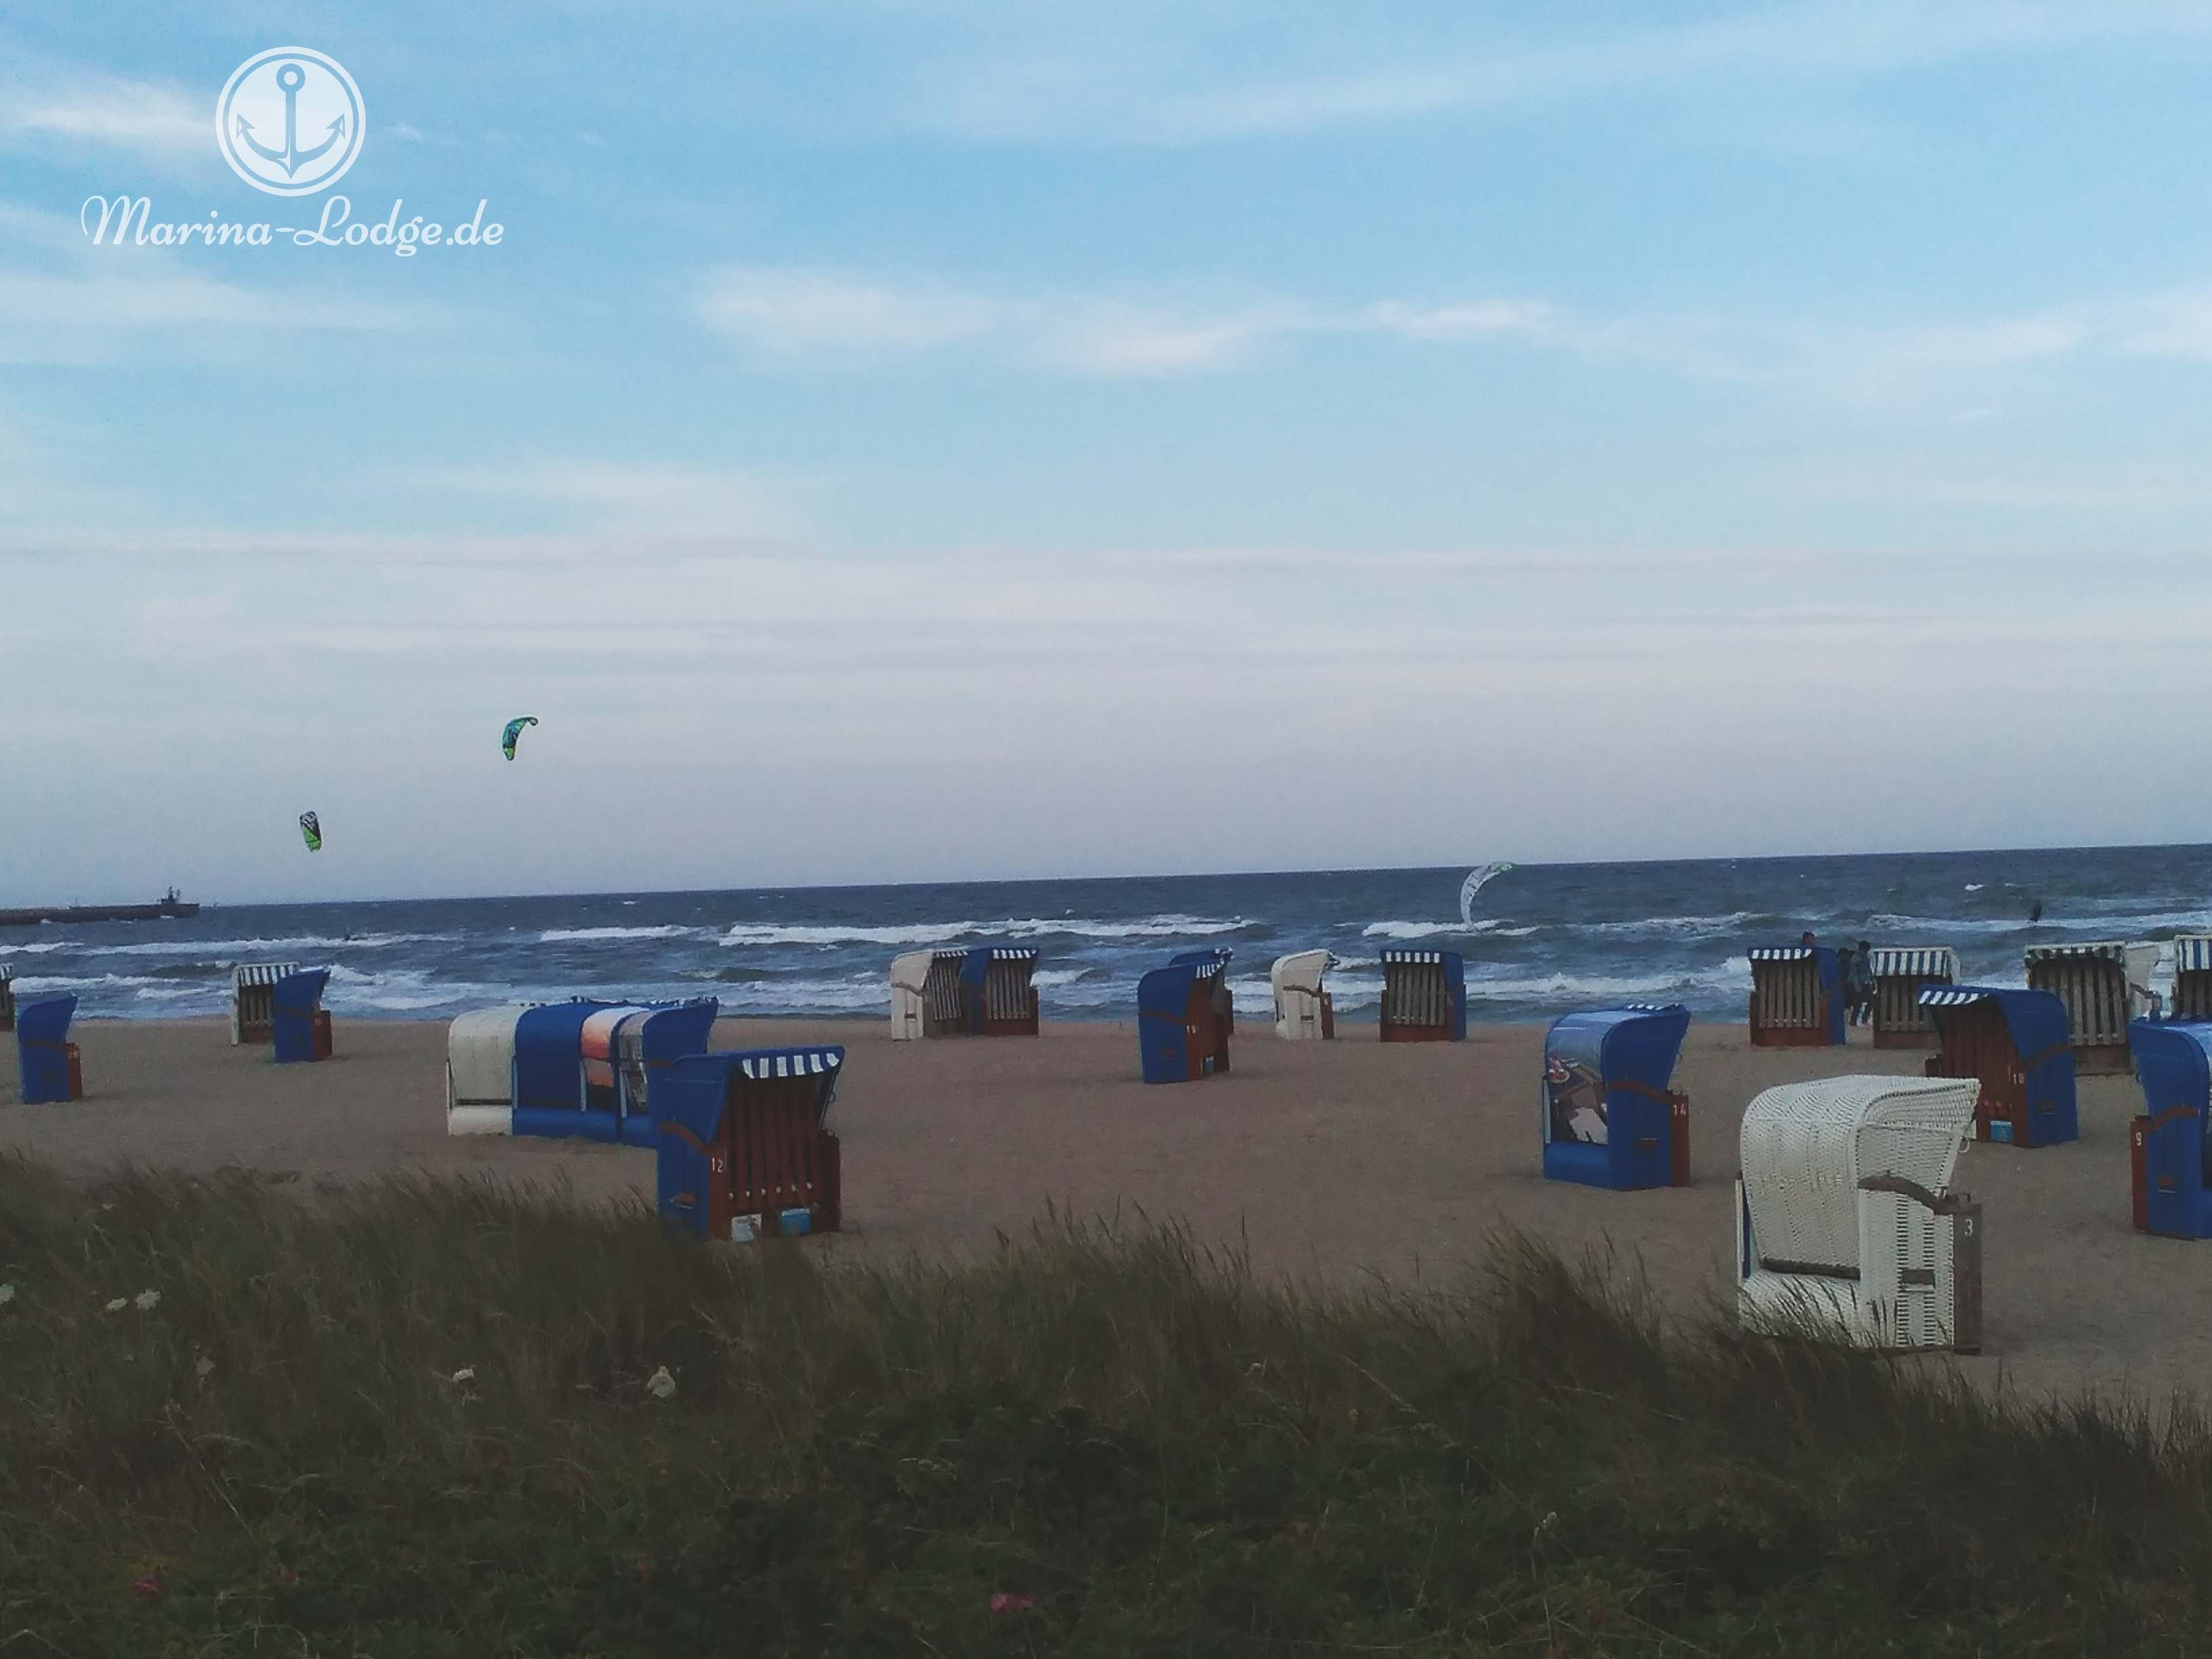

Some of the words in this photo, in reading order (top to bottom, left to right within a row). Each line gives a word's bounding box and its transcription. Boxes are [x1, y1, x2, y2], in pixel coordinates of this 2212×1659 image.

[1673, 1103, 1687, 1117] 14
[2135, 1131, 2142, 1146] 9
[710, 1156, 724, 1173] 12
[1964, 1218, 1973, 1236] 3
